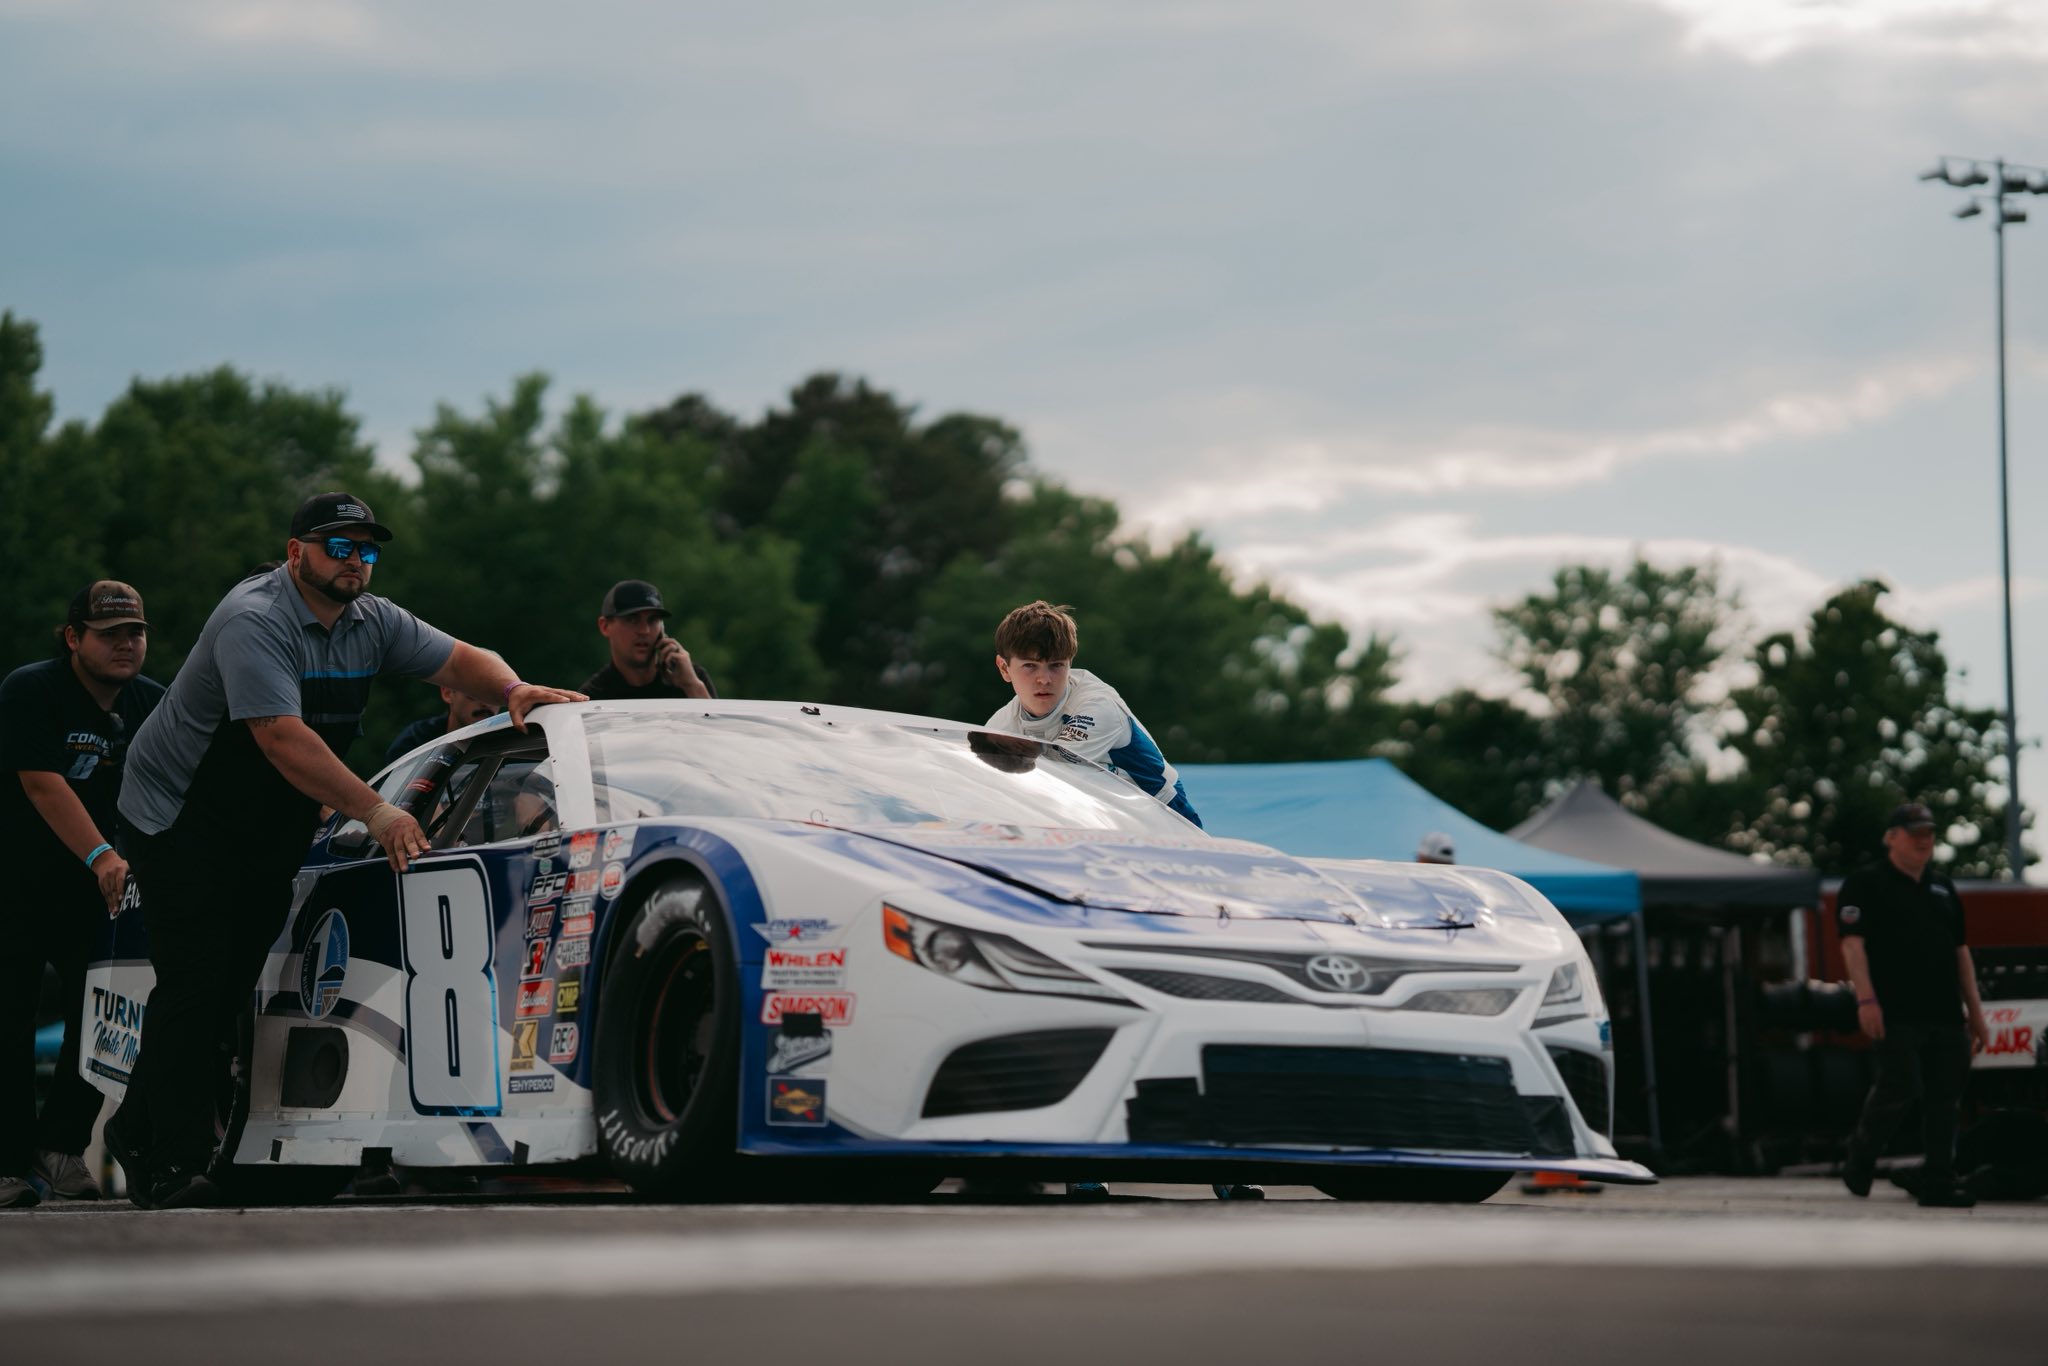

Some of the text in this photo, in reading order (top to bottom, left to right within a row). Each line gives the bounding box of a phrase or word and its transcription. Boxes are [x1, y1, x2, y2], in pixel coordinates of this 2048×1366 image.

[532, 874, 568, 895] PFC
[397, 855, 502, 1116] 8
[93, 986, 146, 1032] TURN
[768, 997, 850, 1020] SIMPSON
[516, 1079, 554, 1092] HYPERCO
